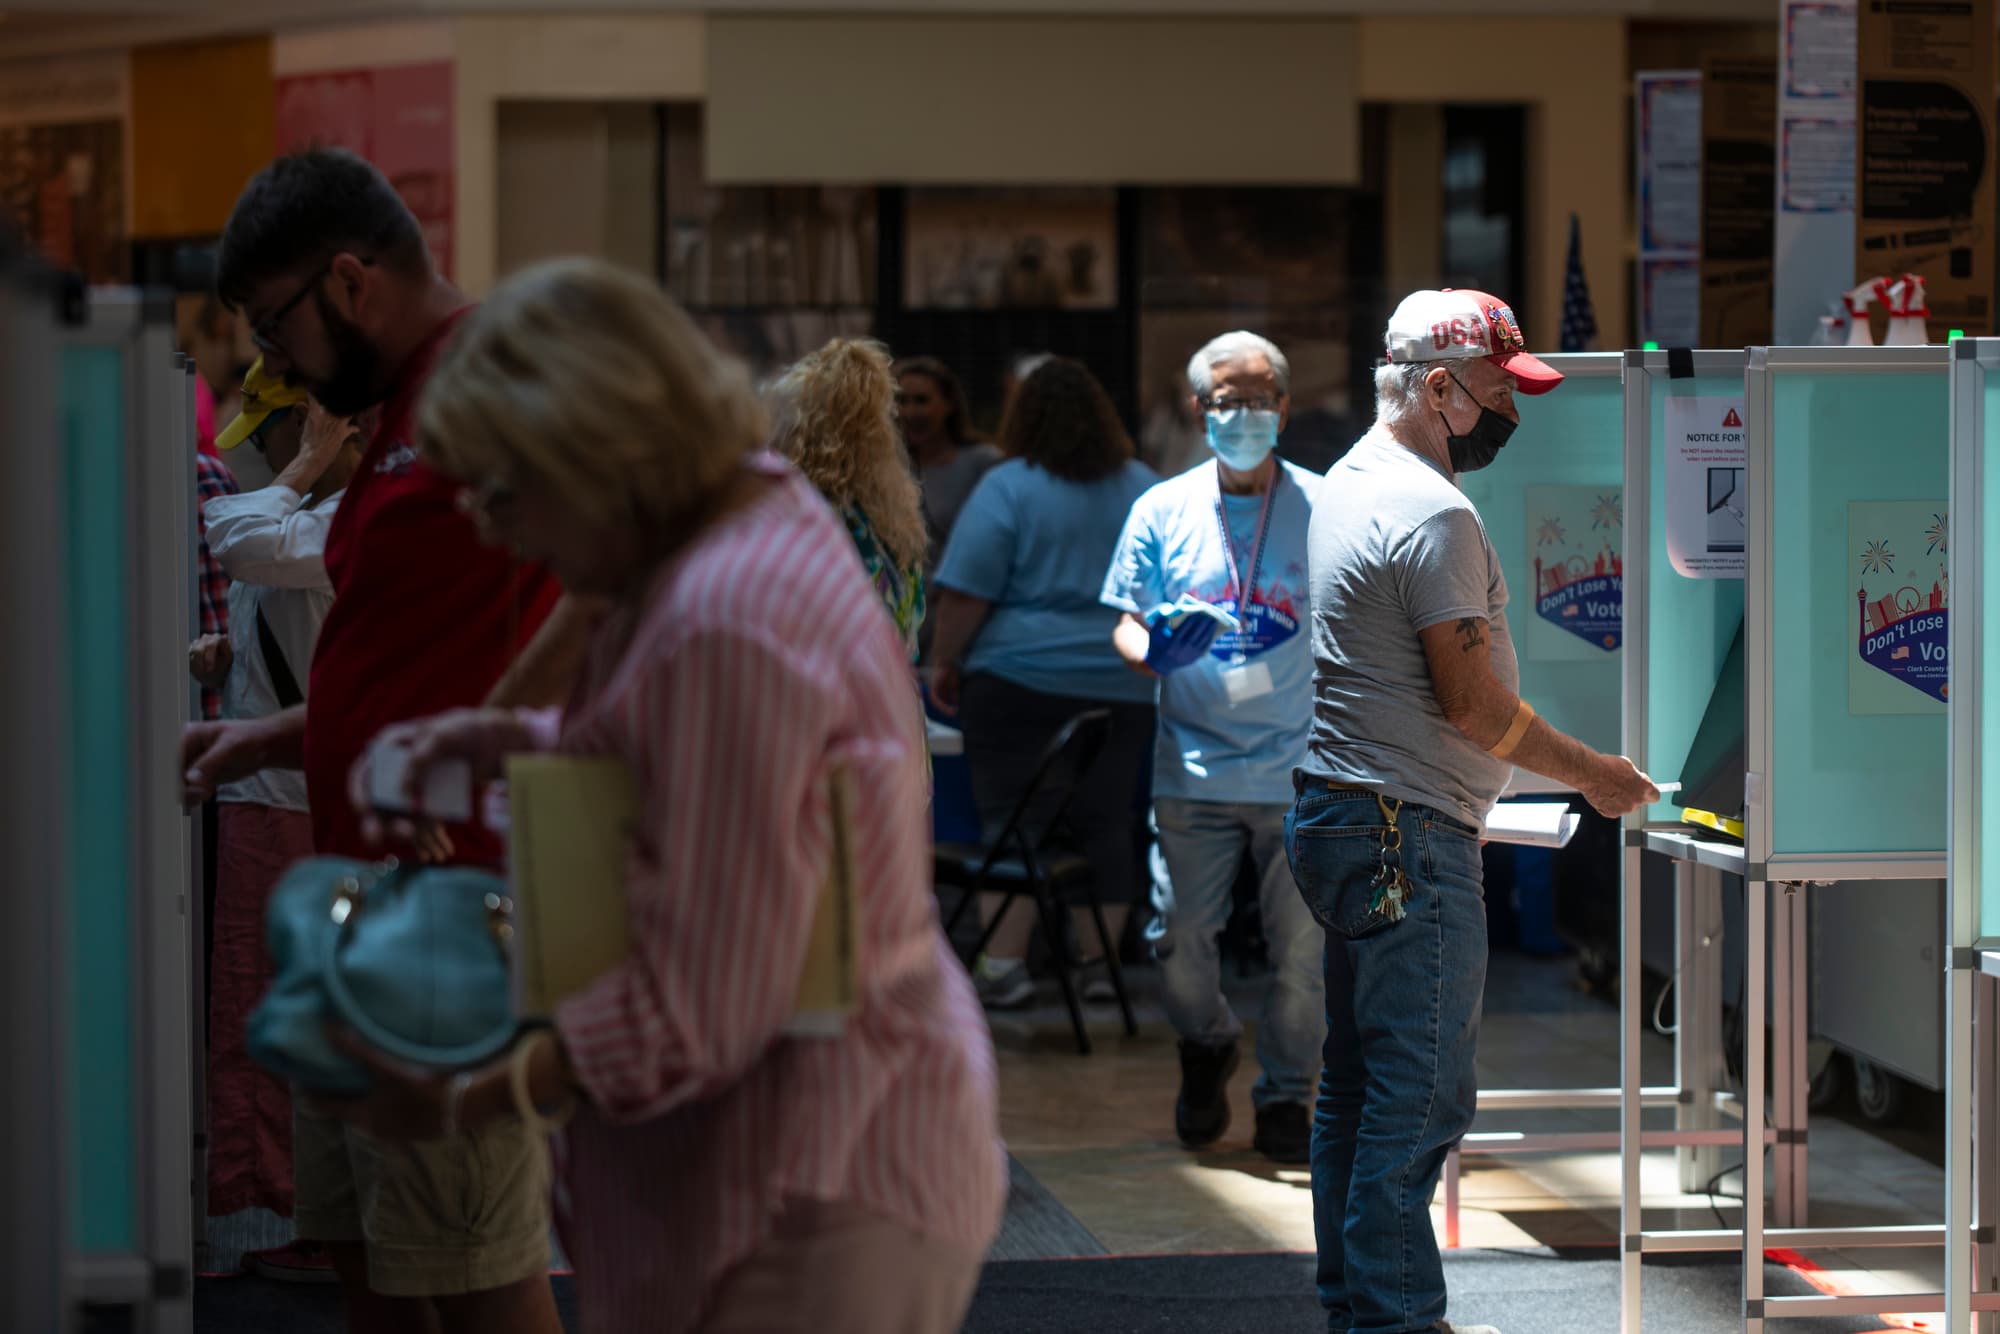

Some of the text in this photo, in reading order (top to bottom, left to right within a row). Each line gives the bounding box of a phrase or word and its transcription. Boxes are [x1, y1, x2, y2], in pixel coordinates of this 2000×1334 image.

[1432, 316, 1487, 351] USA
[1687, 433, 1740, 442] NOTICE FOR
[1541, 587, 1575, 613] Don't
[1577, 579, 1607, 597] Lose
[1867, 615, 1944, 655] Don't Lose
[1919, 642, 1948, 661] Vo
[1924, 665, 1944, 673] County
